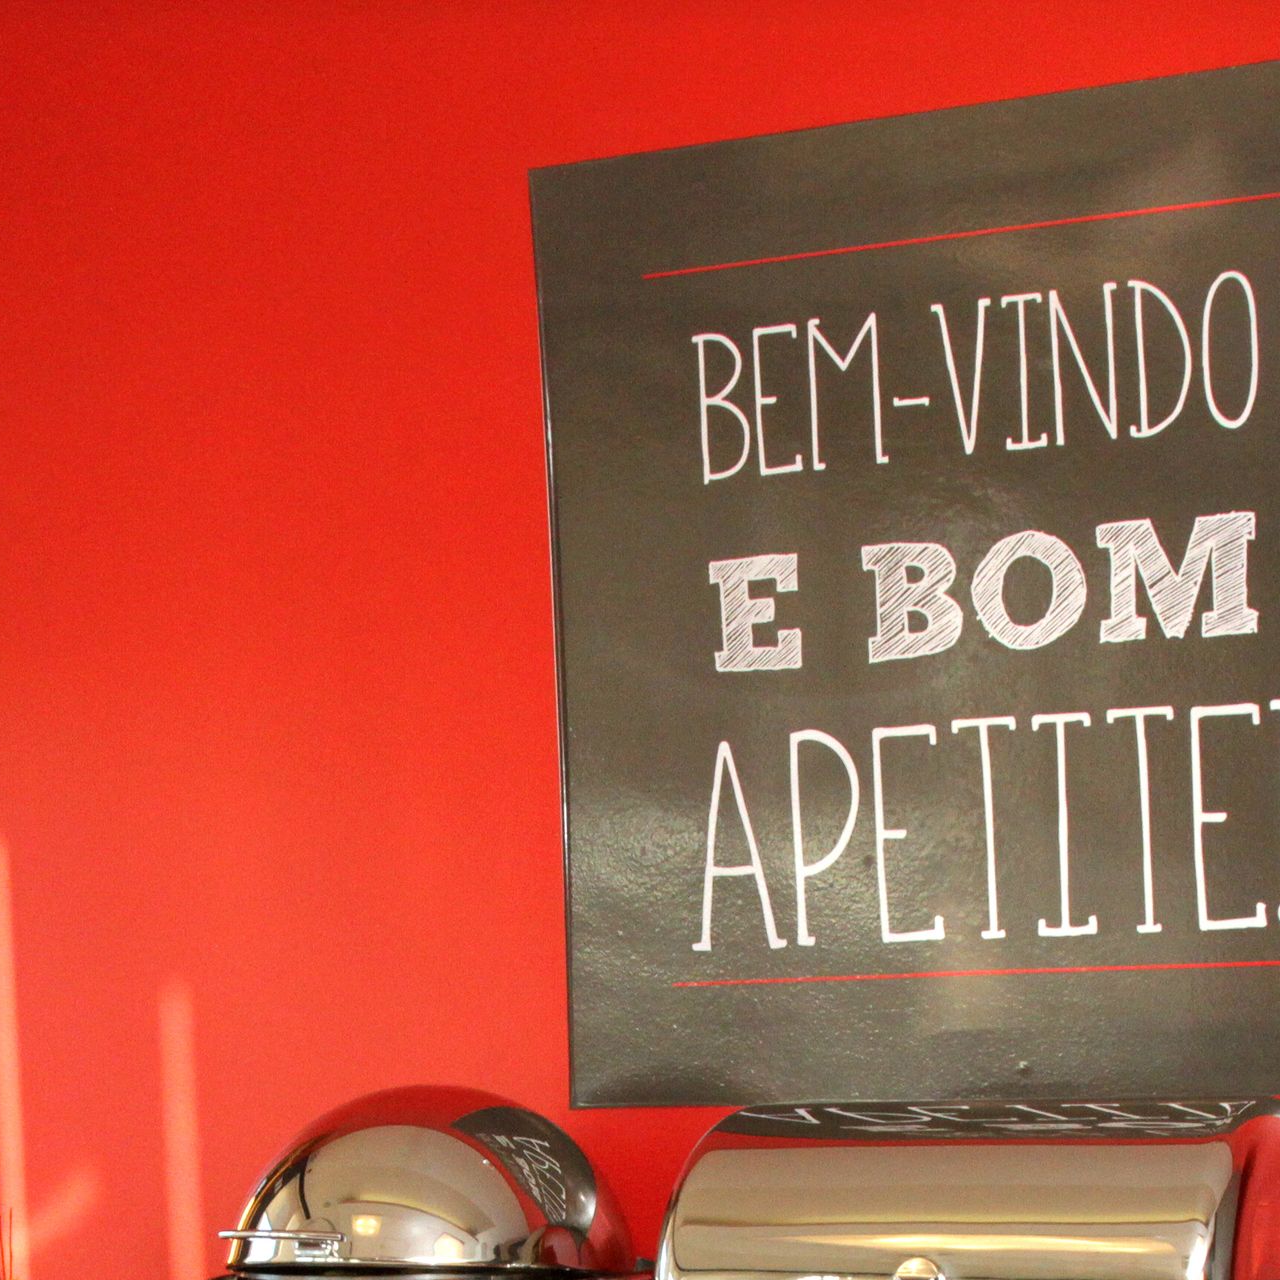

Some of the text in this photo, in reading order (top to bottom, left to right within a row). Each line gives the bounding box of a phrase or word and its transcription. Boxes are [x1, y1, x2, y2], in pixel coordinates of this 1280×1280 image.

[692, 270, 1259, 484] BEM-VINDO
[709, 511, 1259, 671] E BOM
